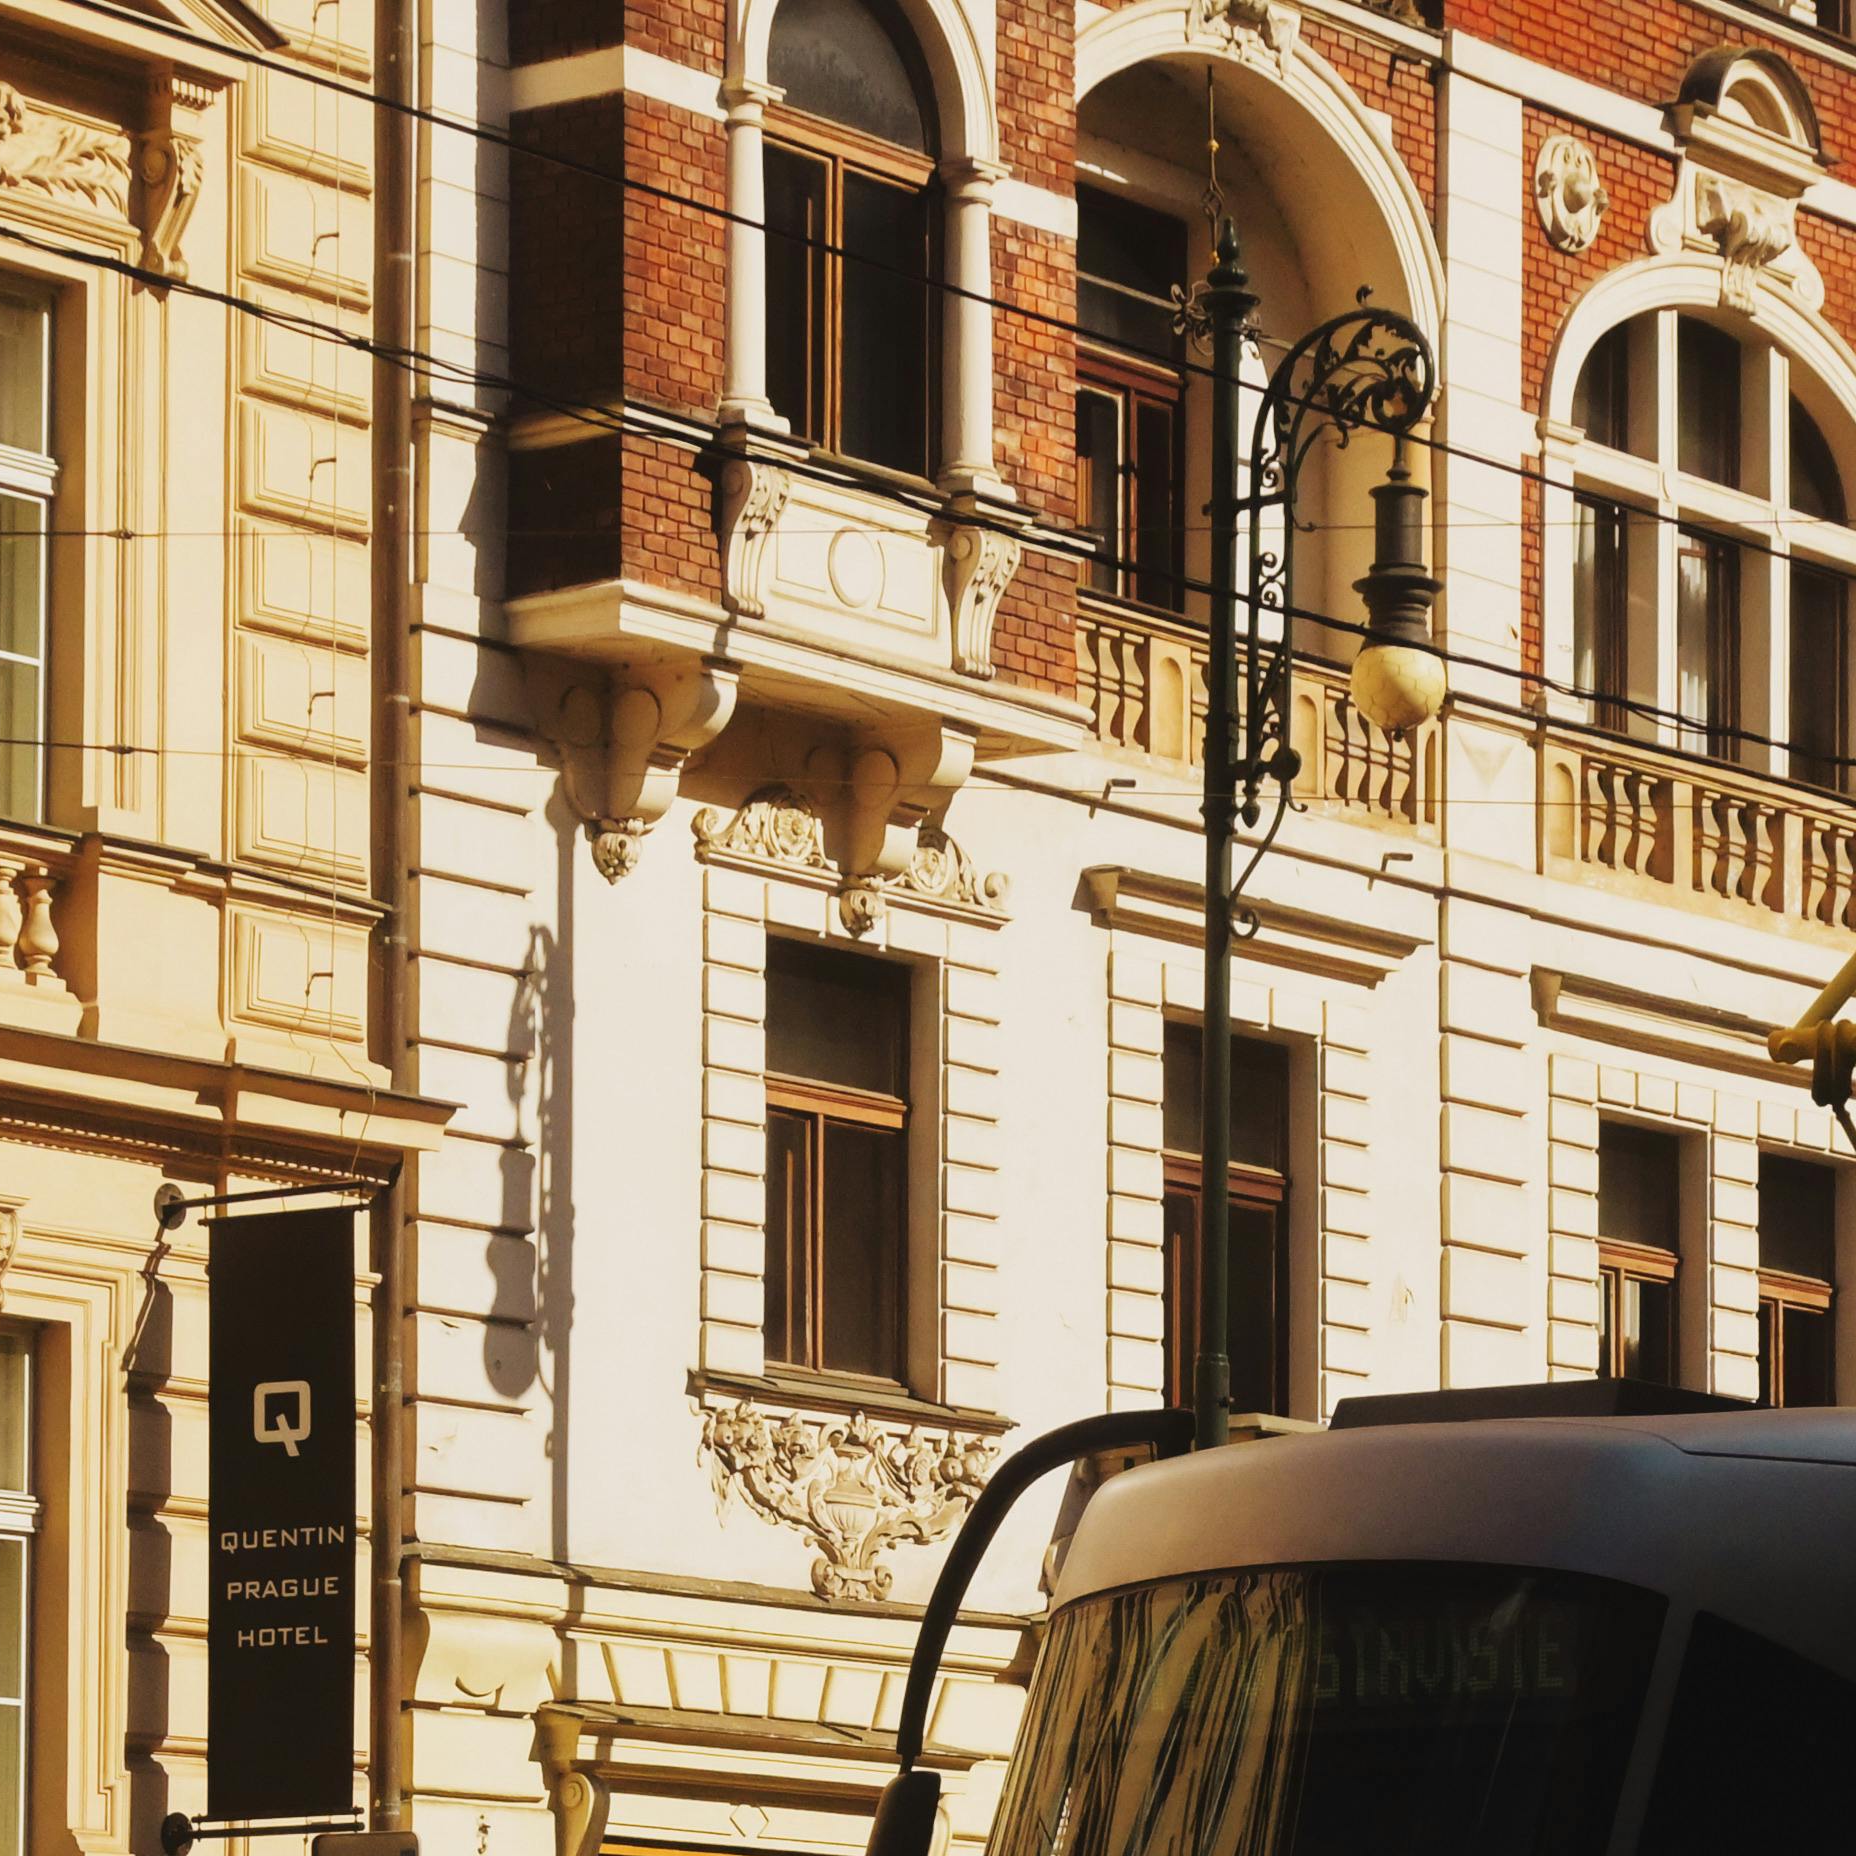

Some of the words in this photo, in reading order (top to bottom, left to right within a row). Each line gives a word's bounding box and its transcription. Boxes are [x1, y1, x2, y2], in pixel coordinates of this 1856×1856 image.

[252, 1379, 313, 1458] Q
[219, 1524, 347, 1554] QUENTIN
[225, 1575, 341, 1602] PRAGUE
[236, 1625, 330, 1649] HOTEL
